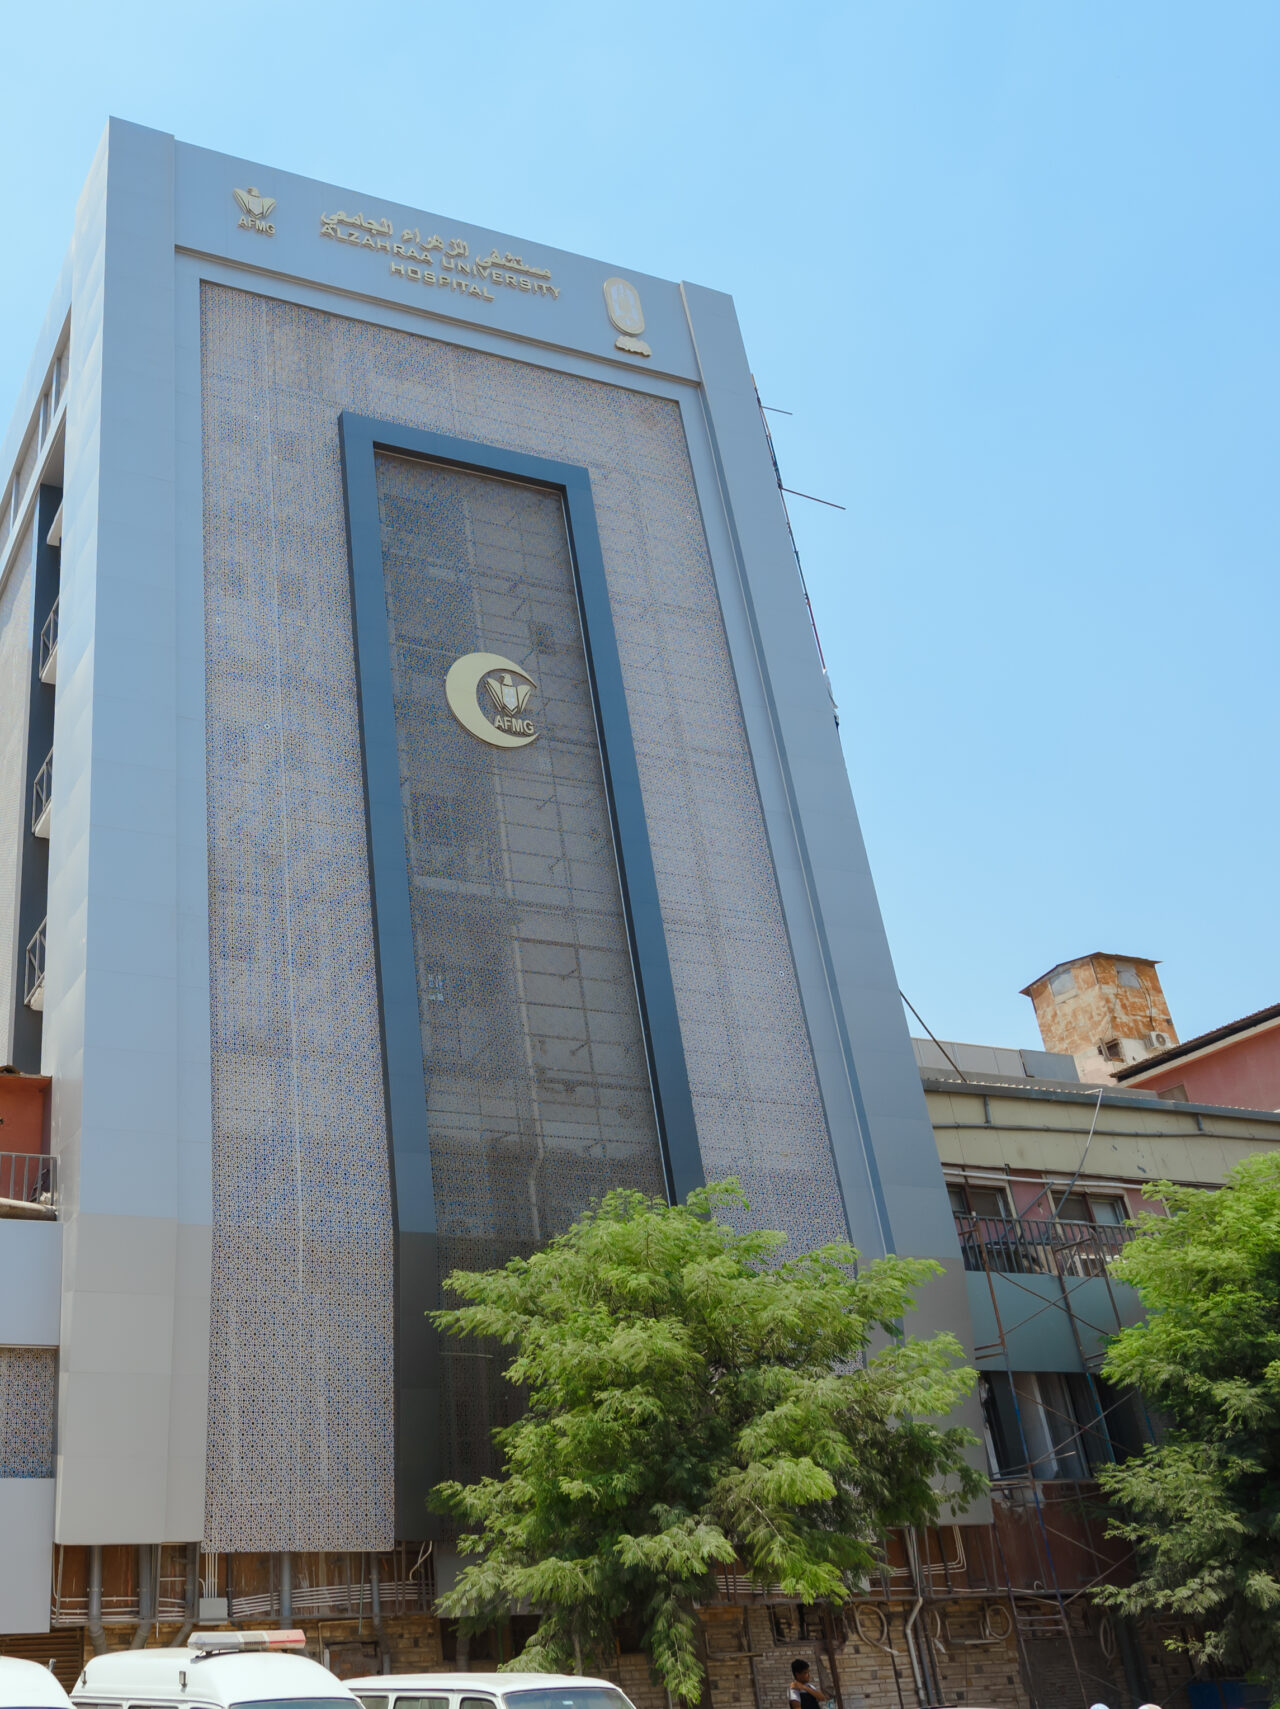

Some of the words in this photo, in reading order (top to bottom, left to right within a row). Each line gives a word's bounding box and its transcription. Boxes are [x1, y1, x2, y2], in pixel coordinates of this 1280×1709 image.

[237, 216, 276, 236] AFMG
[320, 210, 393, 236] الجامعي
[402, 227, 469, 258] الزهراء
[320, 225, 434, 265] ALZAHRAA
[441, 256, 561, 300] UNIVERSITY
[476, 248, 552, 279] مستشفى
[390, 262, 495, 302] HOSPITAL
[495, 715, 534, 734] AFMG
